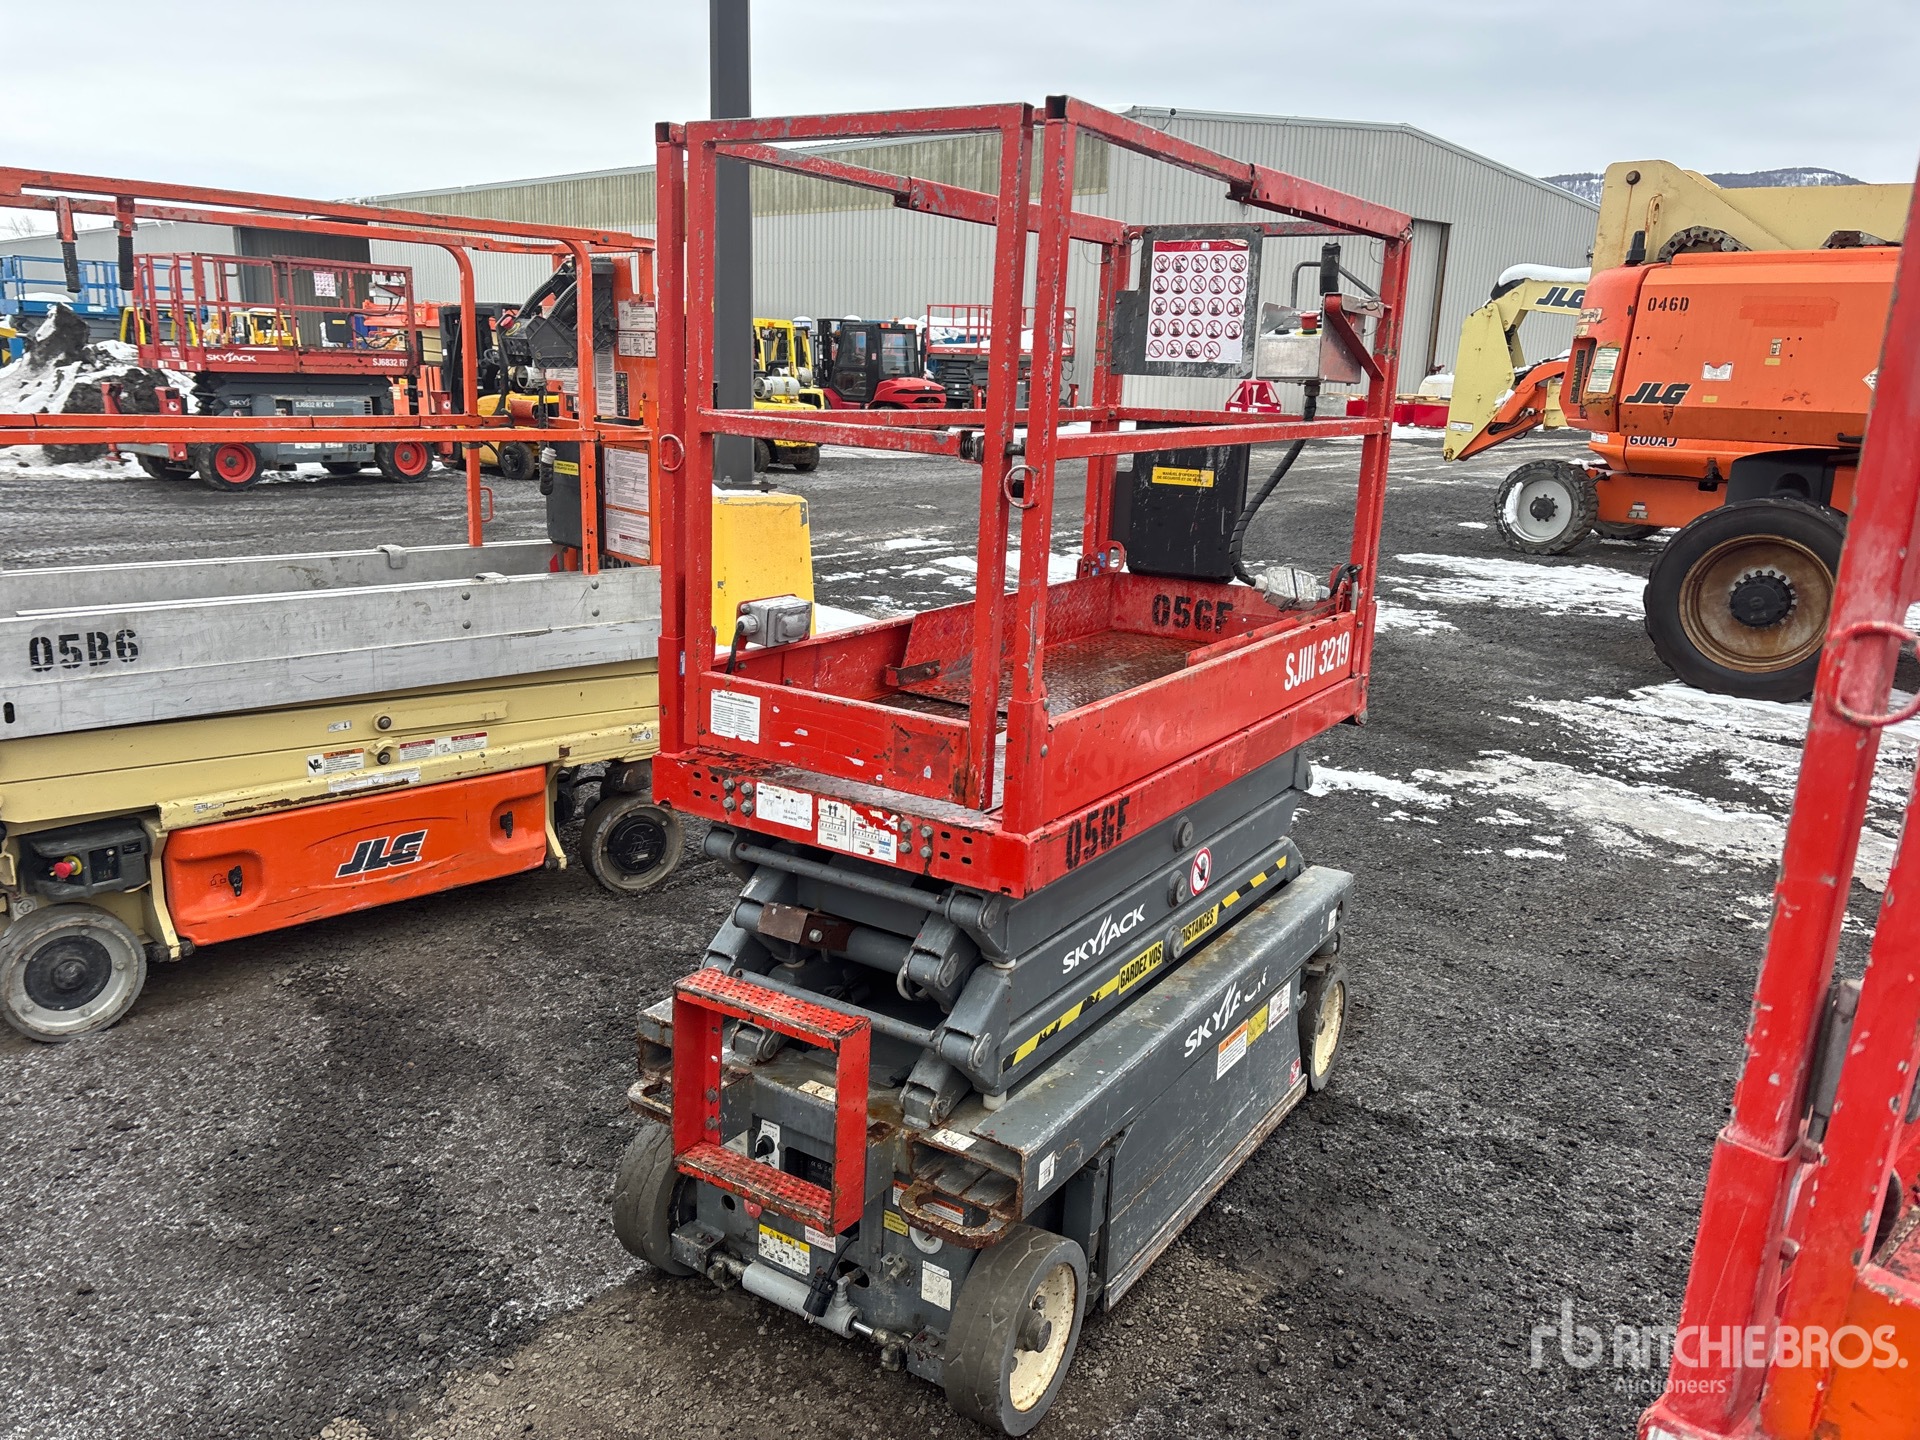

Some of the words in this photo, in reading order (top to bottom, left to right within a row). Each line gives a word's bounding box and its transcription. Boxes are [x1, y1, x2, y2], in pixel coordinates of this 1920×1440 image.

[1535, 286, 1586, 309] JLG
[206, 352, 256, 363] SKYJACK
[372, 357, 398, 367] SJ6832
[399, 358, 408, 367] RT
[229, 397, 252, 407] SKYJ
[1623, 382, 1692, 406] JLG
[1629, 435, 1678, 448] 600AJ
[1151, 593, 1234, 635] 05GF
[29, 629, 139, 672] 05B6
[1318, 631, 1350, 676] 3219
[335, 829, 428, 878] JLG
[1065, 796, 1130, 870] 05GF
[1063, 903, 1146, 975] SKYJACK
[1119, 960, 1148, 988] GARDEZ
[1148, 946, 1163, 968] VOS
